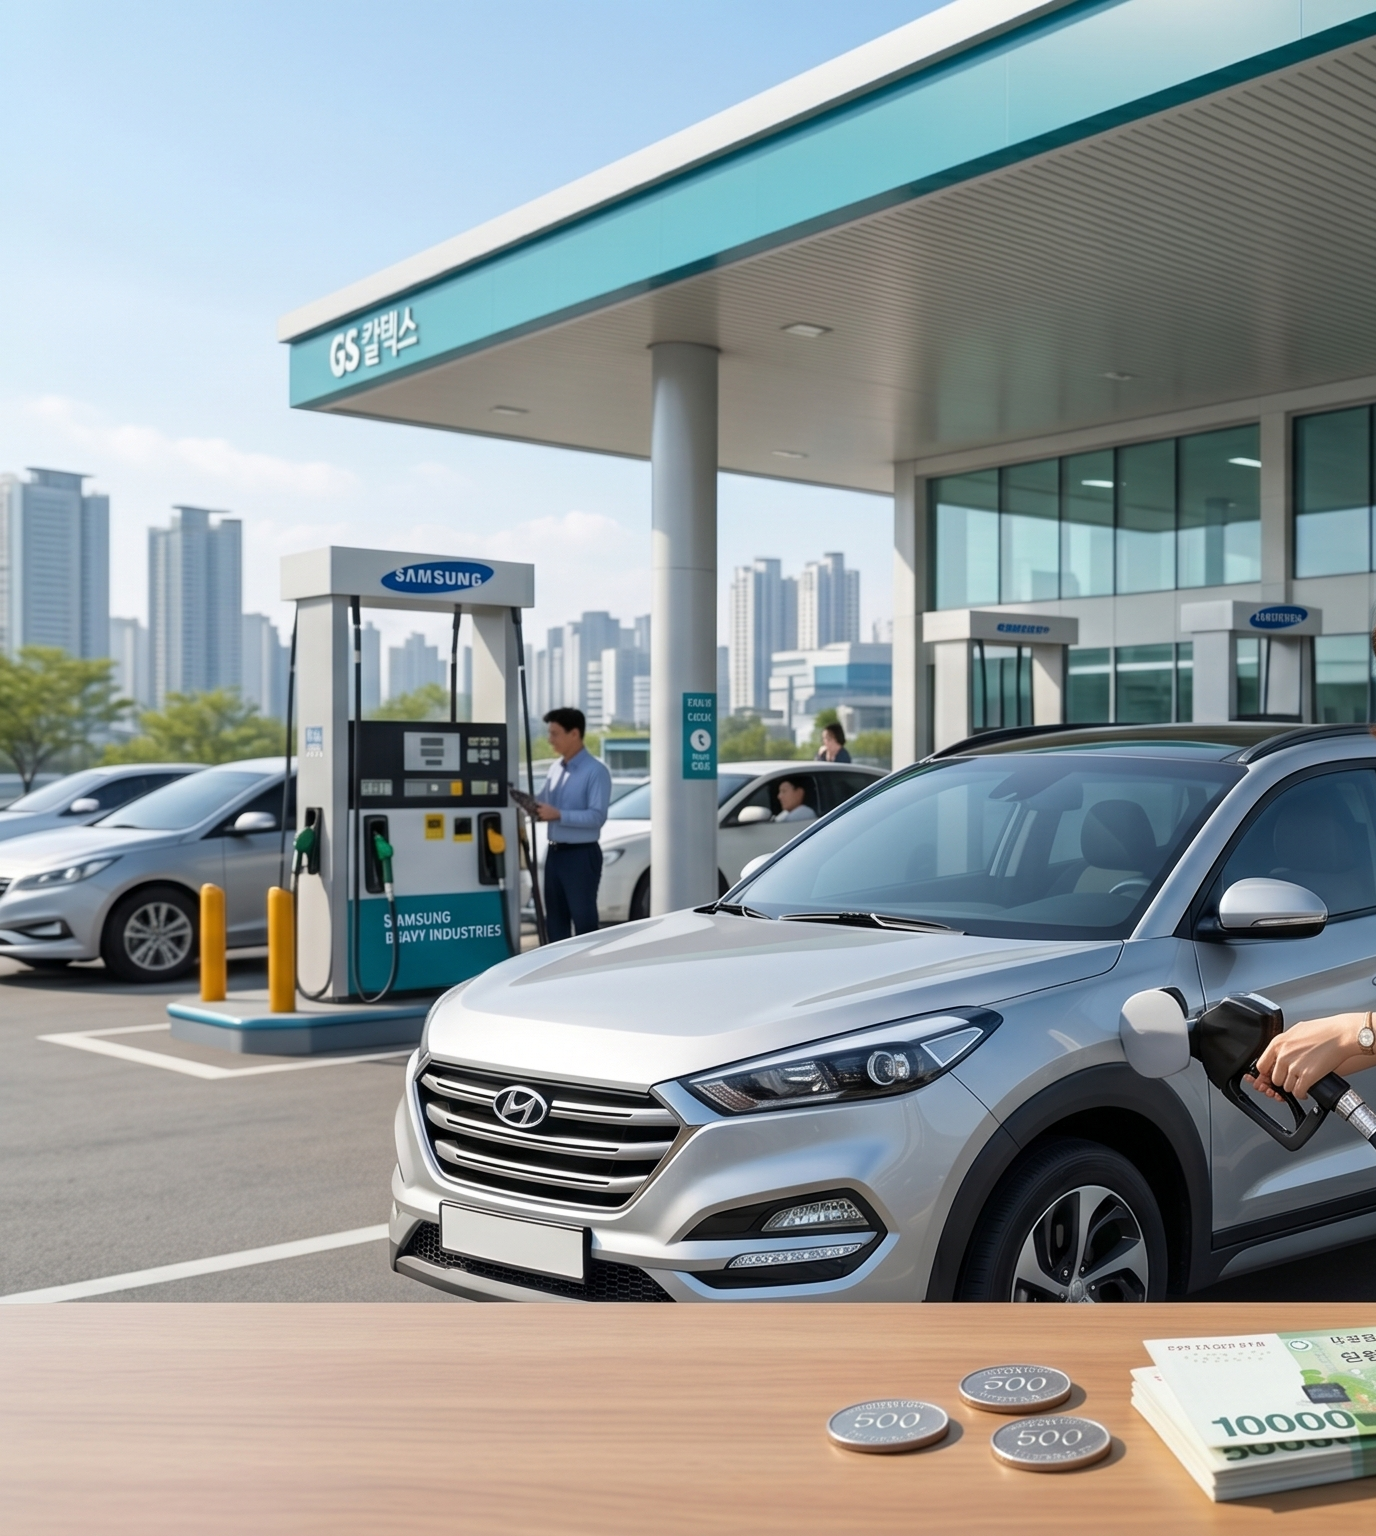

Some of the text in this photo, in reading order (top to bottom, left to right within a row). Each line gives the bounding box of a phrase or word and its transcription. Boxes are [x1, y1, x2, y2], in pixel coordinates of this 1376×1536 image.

[330, 306, 418, 378] GS 칼텍스
[394, 568, 483, 588] SAMSUNG
[383, 911, 452, 929] SAMSUNG
[429, 924, 502, 941] INDUSTRIES
[984, 1376, 1047, 1392] 500
[854, 1412, 921, 1429] 500
[1211, 1409, 1356, 1437] 10000
[1017, 1428, 1083, 1447] 500
